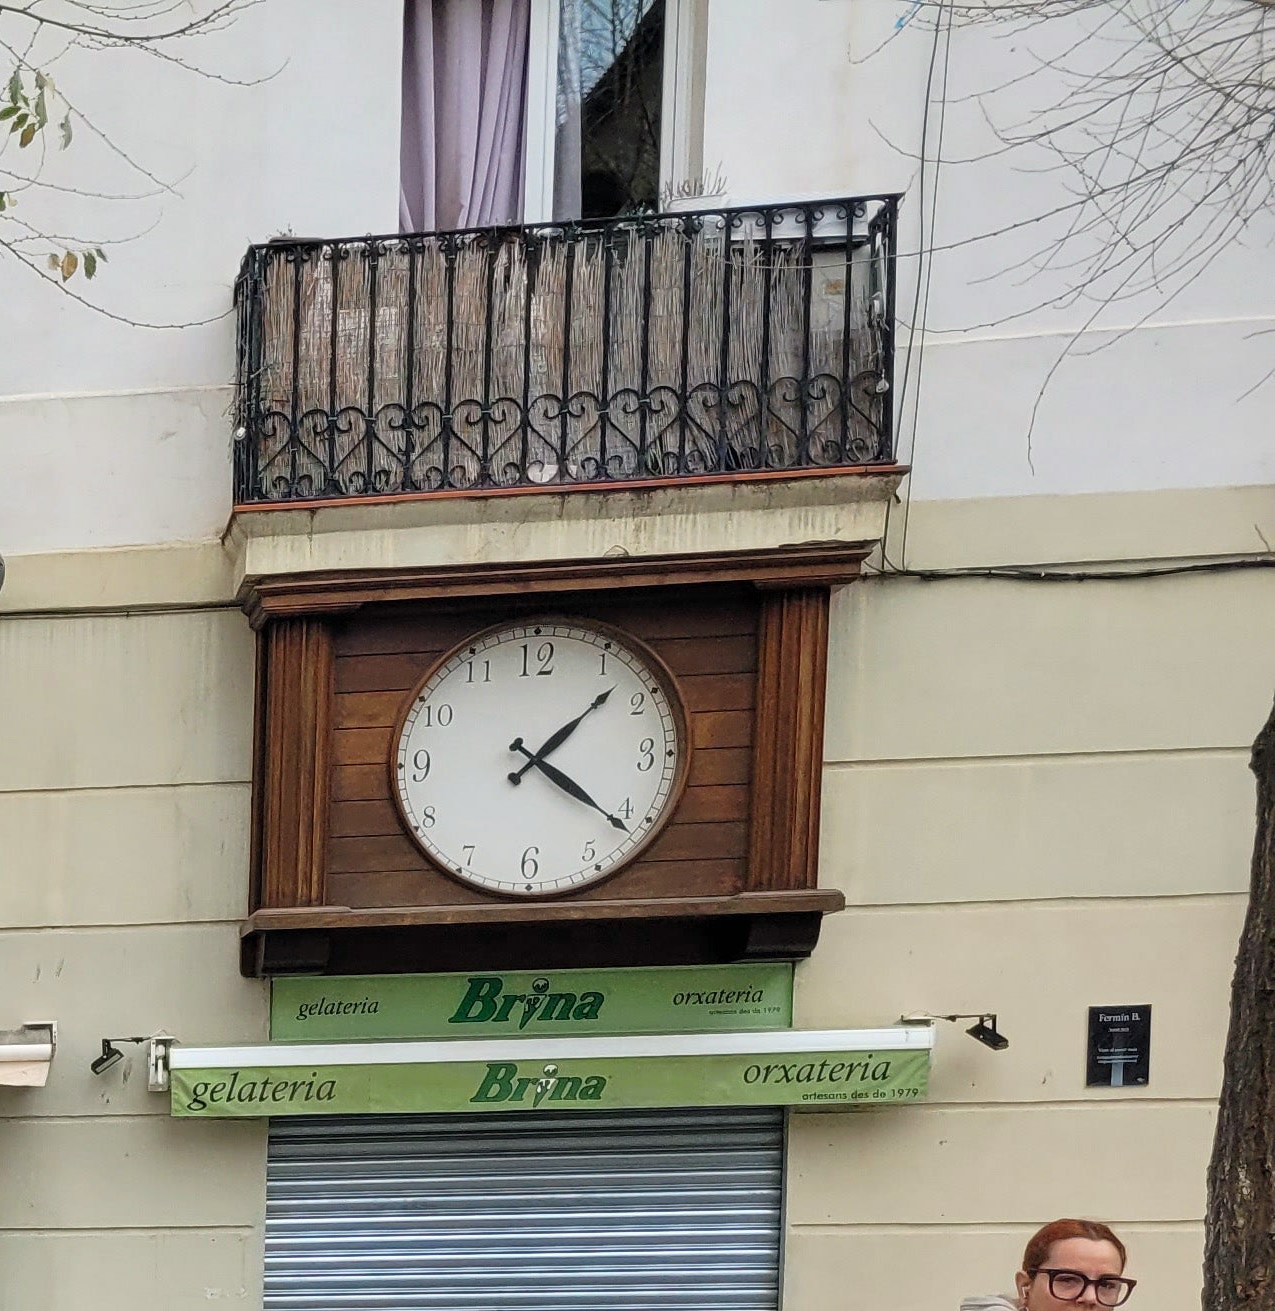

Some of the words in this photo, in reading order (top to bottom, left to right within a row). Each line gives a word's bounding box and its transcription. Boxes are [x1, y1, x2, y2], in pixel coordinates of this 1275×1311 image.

[465, 660, 492, 683] 11
[519, 642, 555, 677] 12
[598, 653, 608, 676] 1
[424, 704, 454, 728] 10
[630, 692, 646, 716] 2
[412, 749, 432, 783] 9
[637, 738, 655, 772] 3
[422, 806, 436, 829] 8
[618, 797, 635, 820] 4
[462, 845, 476, 867] 7
[582, 839, 596, 862] 5
[521, 846, 540, 880] 6
[672, 984, 764, 1006] orxateria
[296, 996, 380, 1021] gelateria
[743, 1053, 892, 1084] orxateria
[187, 1071, 337, 1111] gelateria
[802, 1092, 847, 1101] artesans
[851, 1090, 870, 1099] des
[892, 1088, 919, 1098] 1979
